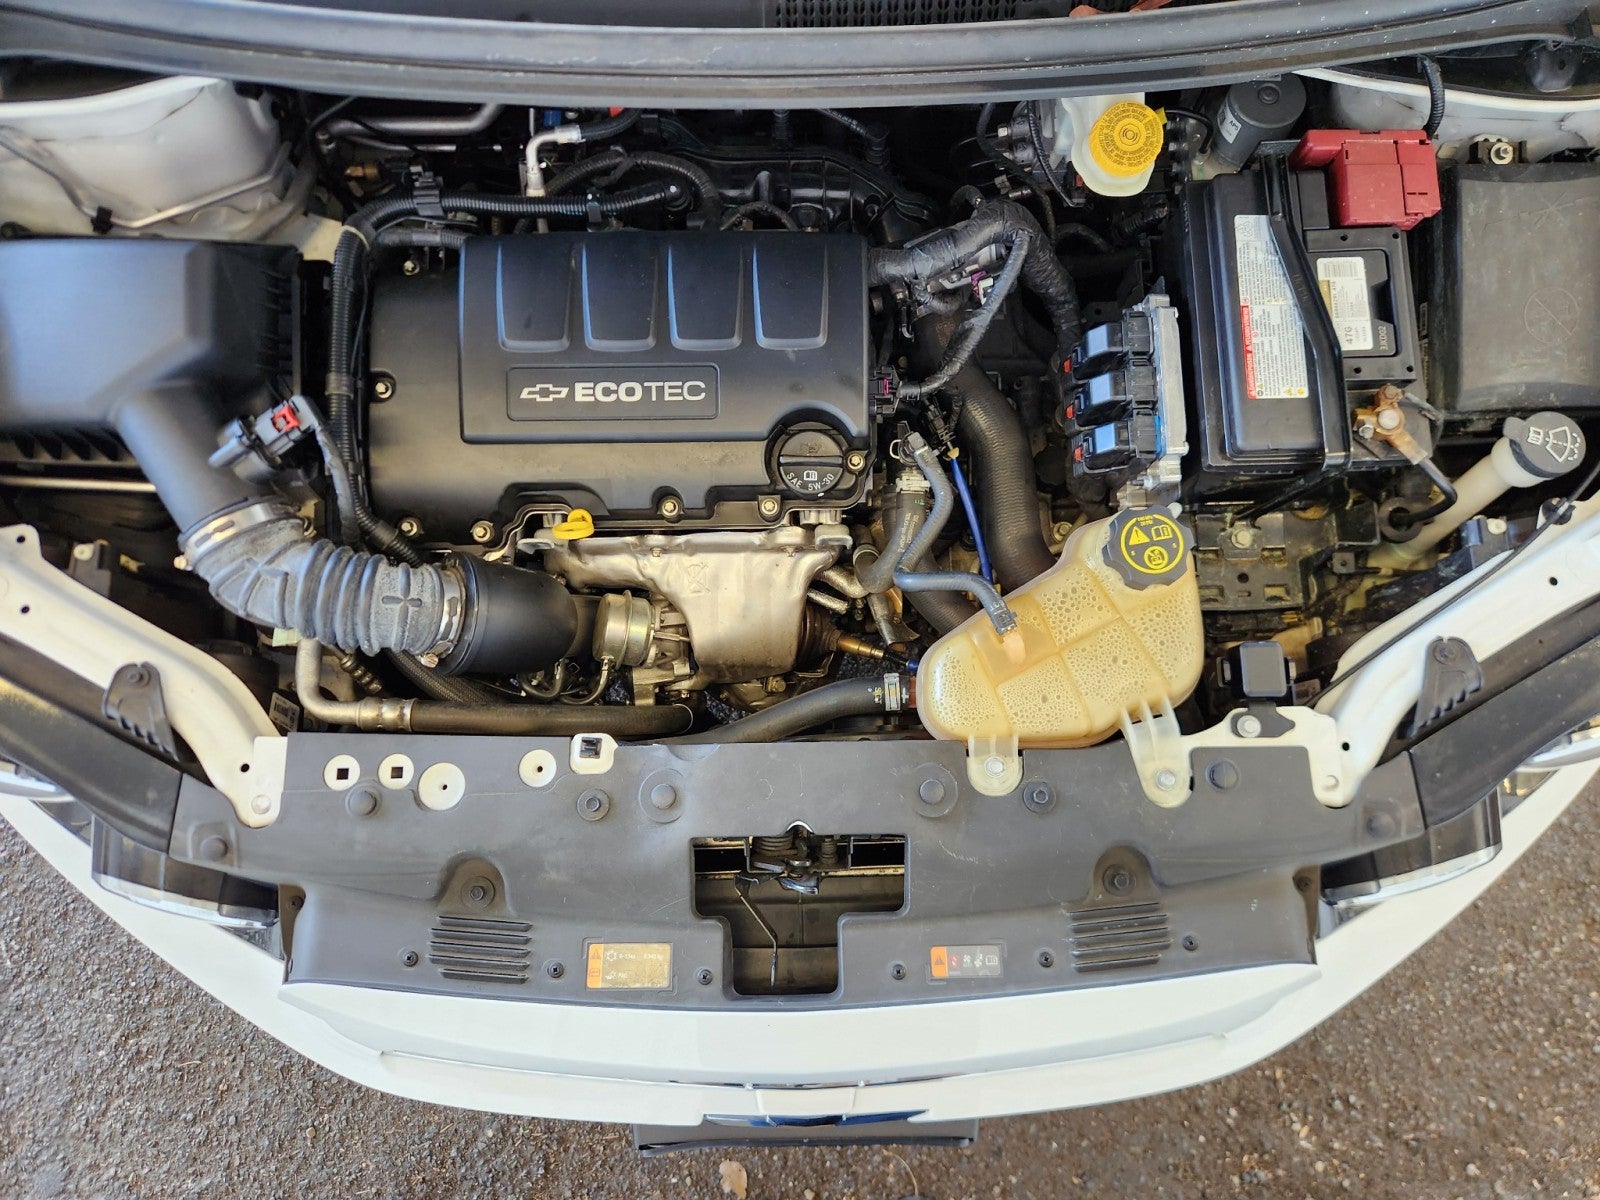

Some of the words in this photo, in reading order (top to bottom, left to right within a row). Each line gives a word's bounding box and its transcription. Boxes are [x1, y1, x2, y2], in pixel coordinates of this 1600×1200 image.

[574, 380, 706, 402] ECOTEC
[786, 472, 803, 488] SAE
[807, 473, 835, 491] 5W-30
